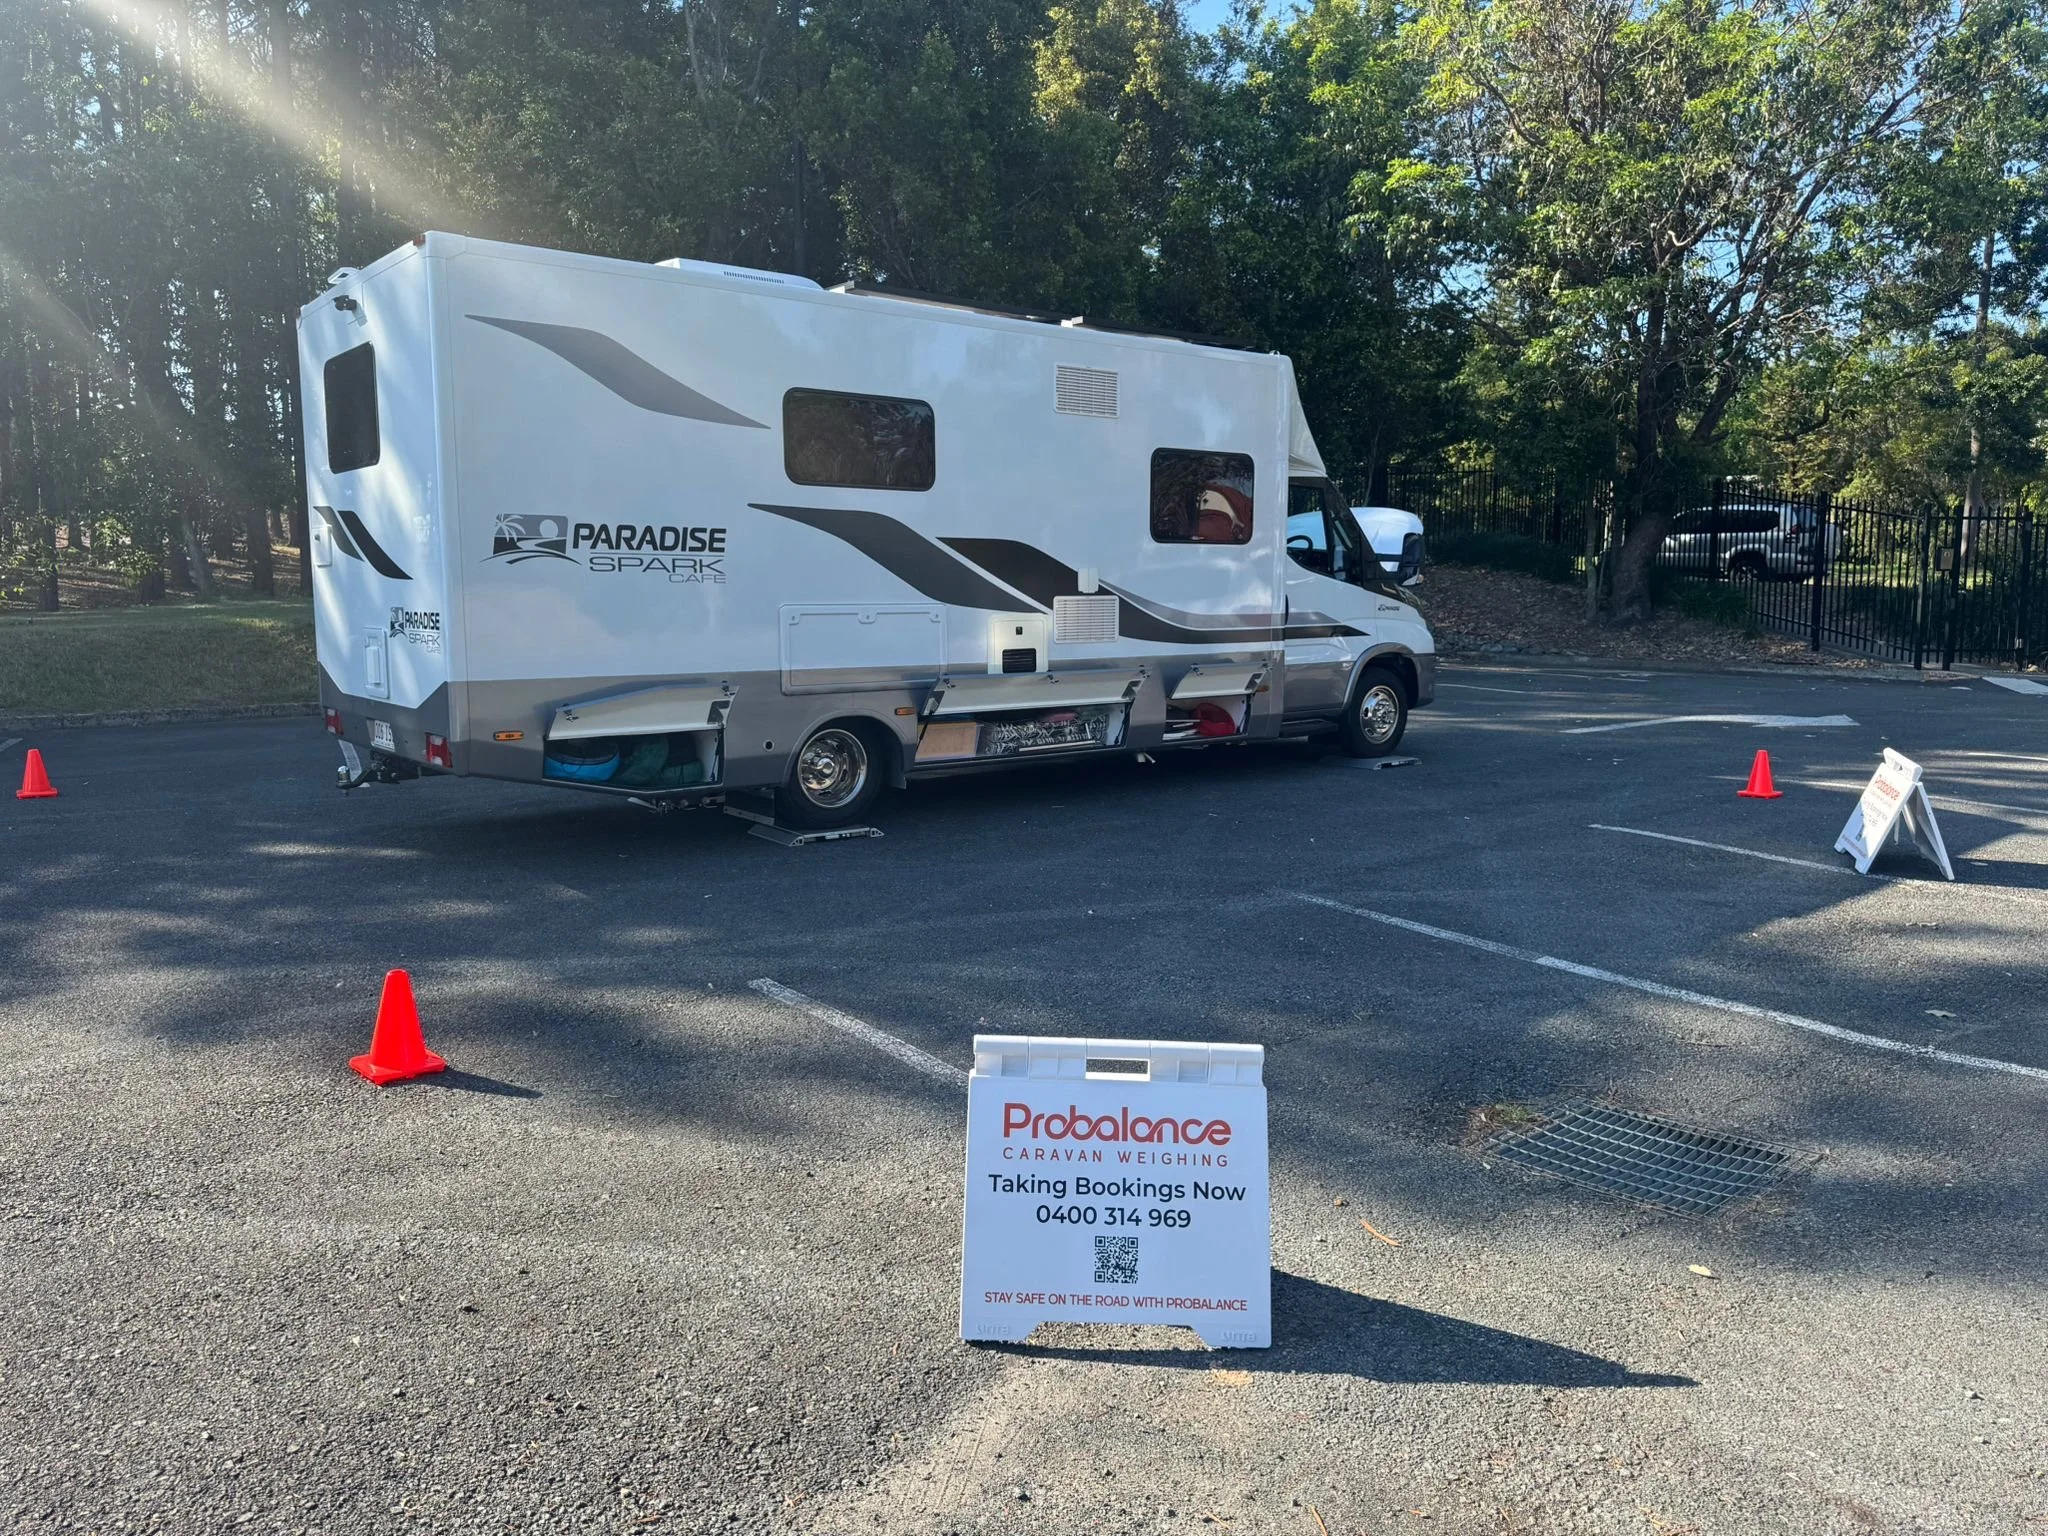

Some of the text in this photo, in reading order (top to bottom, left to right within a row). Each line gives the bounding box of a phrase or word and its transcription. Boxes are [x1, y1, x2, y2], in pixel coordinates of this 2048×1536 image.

[573, 522, 727, 553] PARADISE
[589, 556, 727, 575] SPARK
[668, 573, 727, 584] CAFE
[404, 611, 440, 631] PARADISE
[408, 633, 440, 647] SPARK
[1003, 1102, 1232, 1146] Probalance
[1002, 1147, 1229, 1168] CARAVAN WEIGHING
[988, 1174, 1247, 1203] Taking Bookings Now
[1036, 1204, 1192, 1228] 0400 314 969
[984, 1291, 1248, 1311] STAY SAFE ON THE ROAD WITH PROBALANCE
